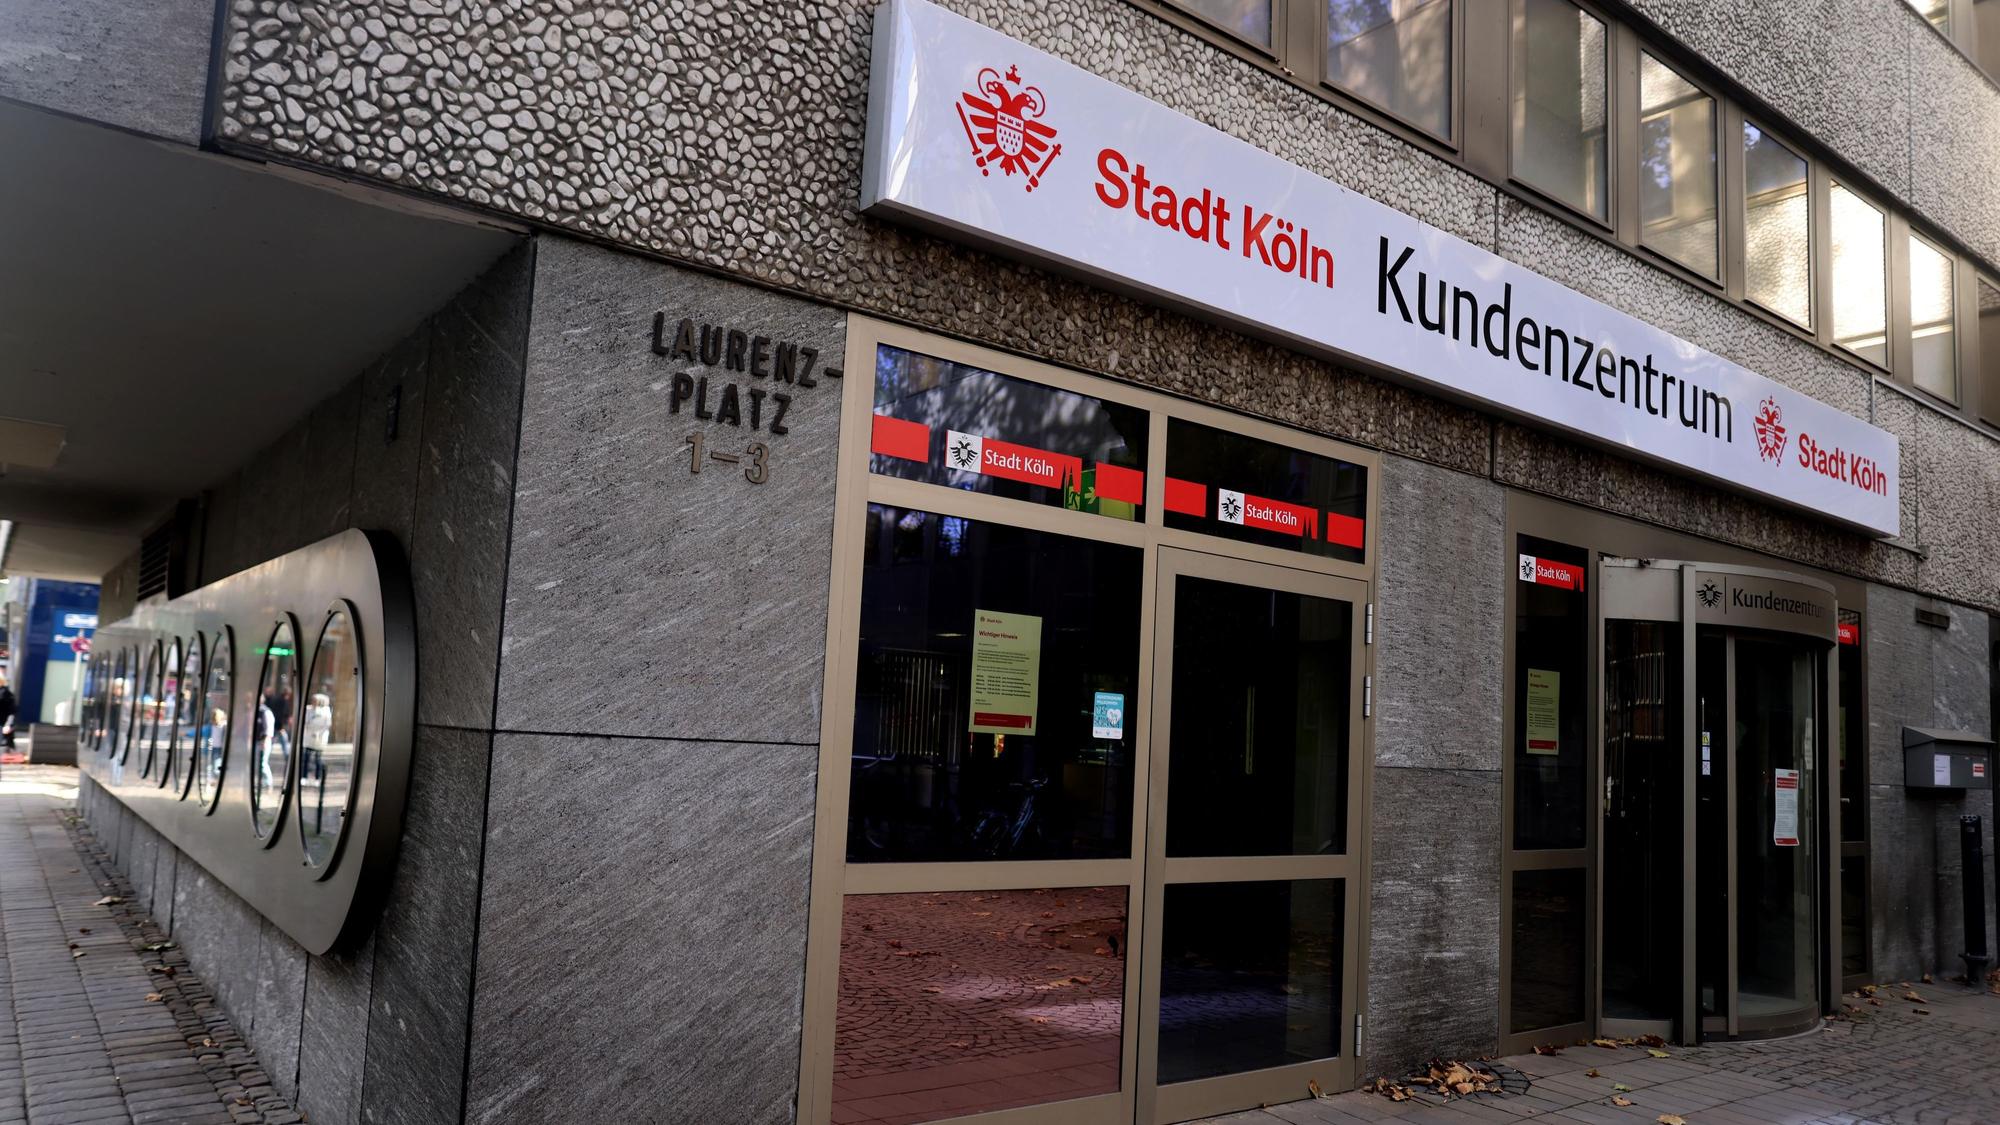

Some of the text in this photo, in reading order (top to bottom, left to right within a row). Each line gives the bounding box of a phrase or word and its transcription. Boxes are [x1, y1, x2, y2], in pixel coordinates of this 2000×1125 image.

[1094, 148, 1335, 290] Stadt Köln
[652, 311, 843, 388] LAURENZ-
[1377, 235, 1733, 443] Kundenzentrum
[670, 372, 792, 435] PLATZ
[984, 449, 1054, 477] Stadt Köln
[1798, 432, 1887, 497] Stadt Köln
[1246, 503, 1298, 526] Stadt Köln
[1536, 565, 1571, 582] Stadt Köln
